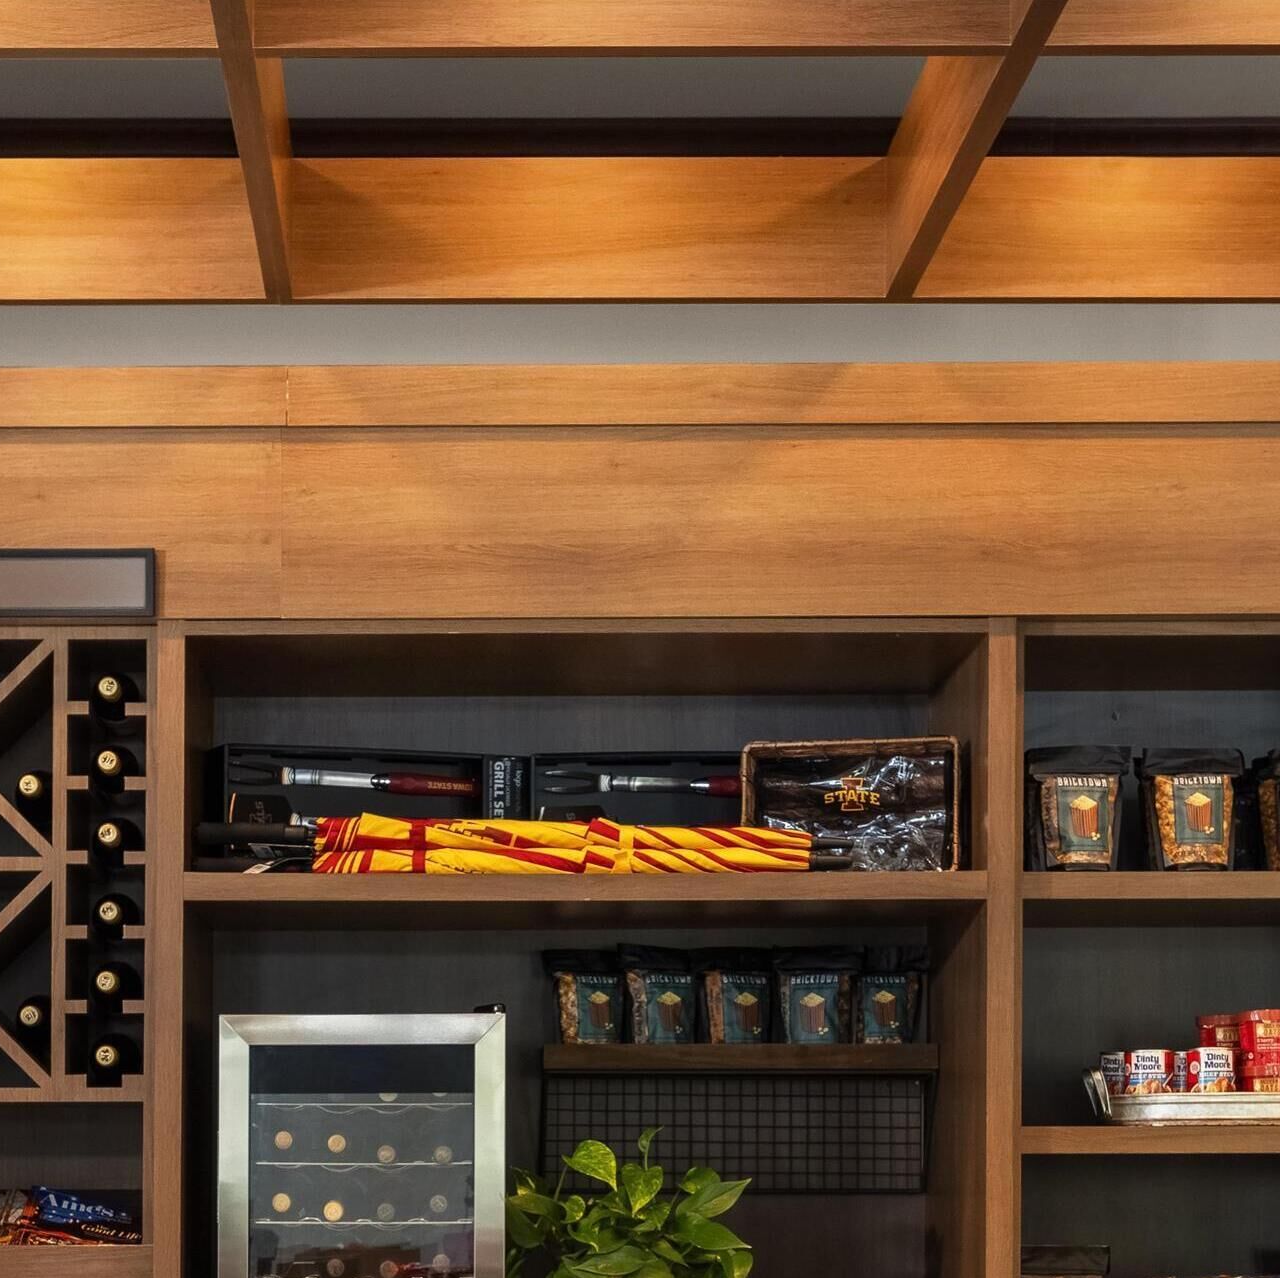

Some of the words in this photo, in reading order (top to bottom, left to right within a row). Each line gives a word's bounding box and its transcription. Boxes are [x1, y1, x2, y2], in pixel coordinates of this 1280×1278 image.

[493, 761, 505, 798] GRILL
[824, 789, 881, 806] STATE
[1136, 1055, 1160, 1065] Dinty
[1206, 1053, 1229, 1063] Dinty
[1134, 1063, 1162, 1071] Moore
[1205, 1060, 1232, 1069] Moore
